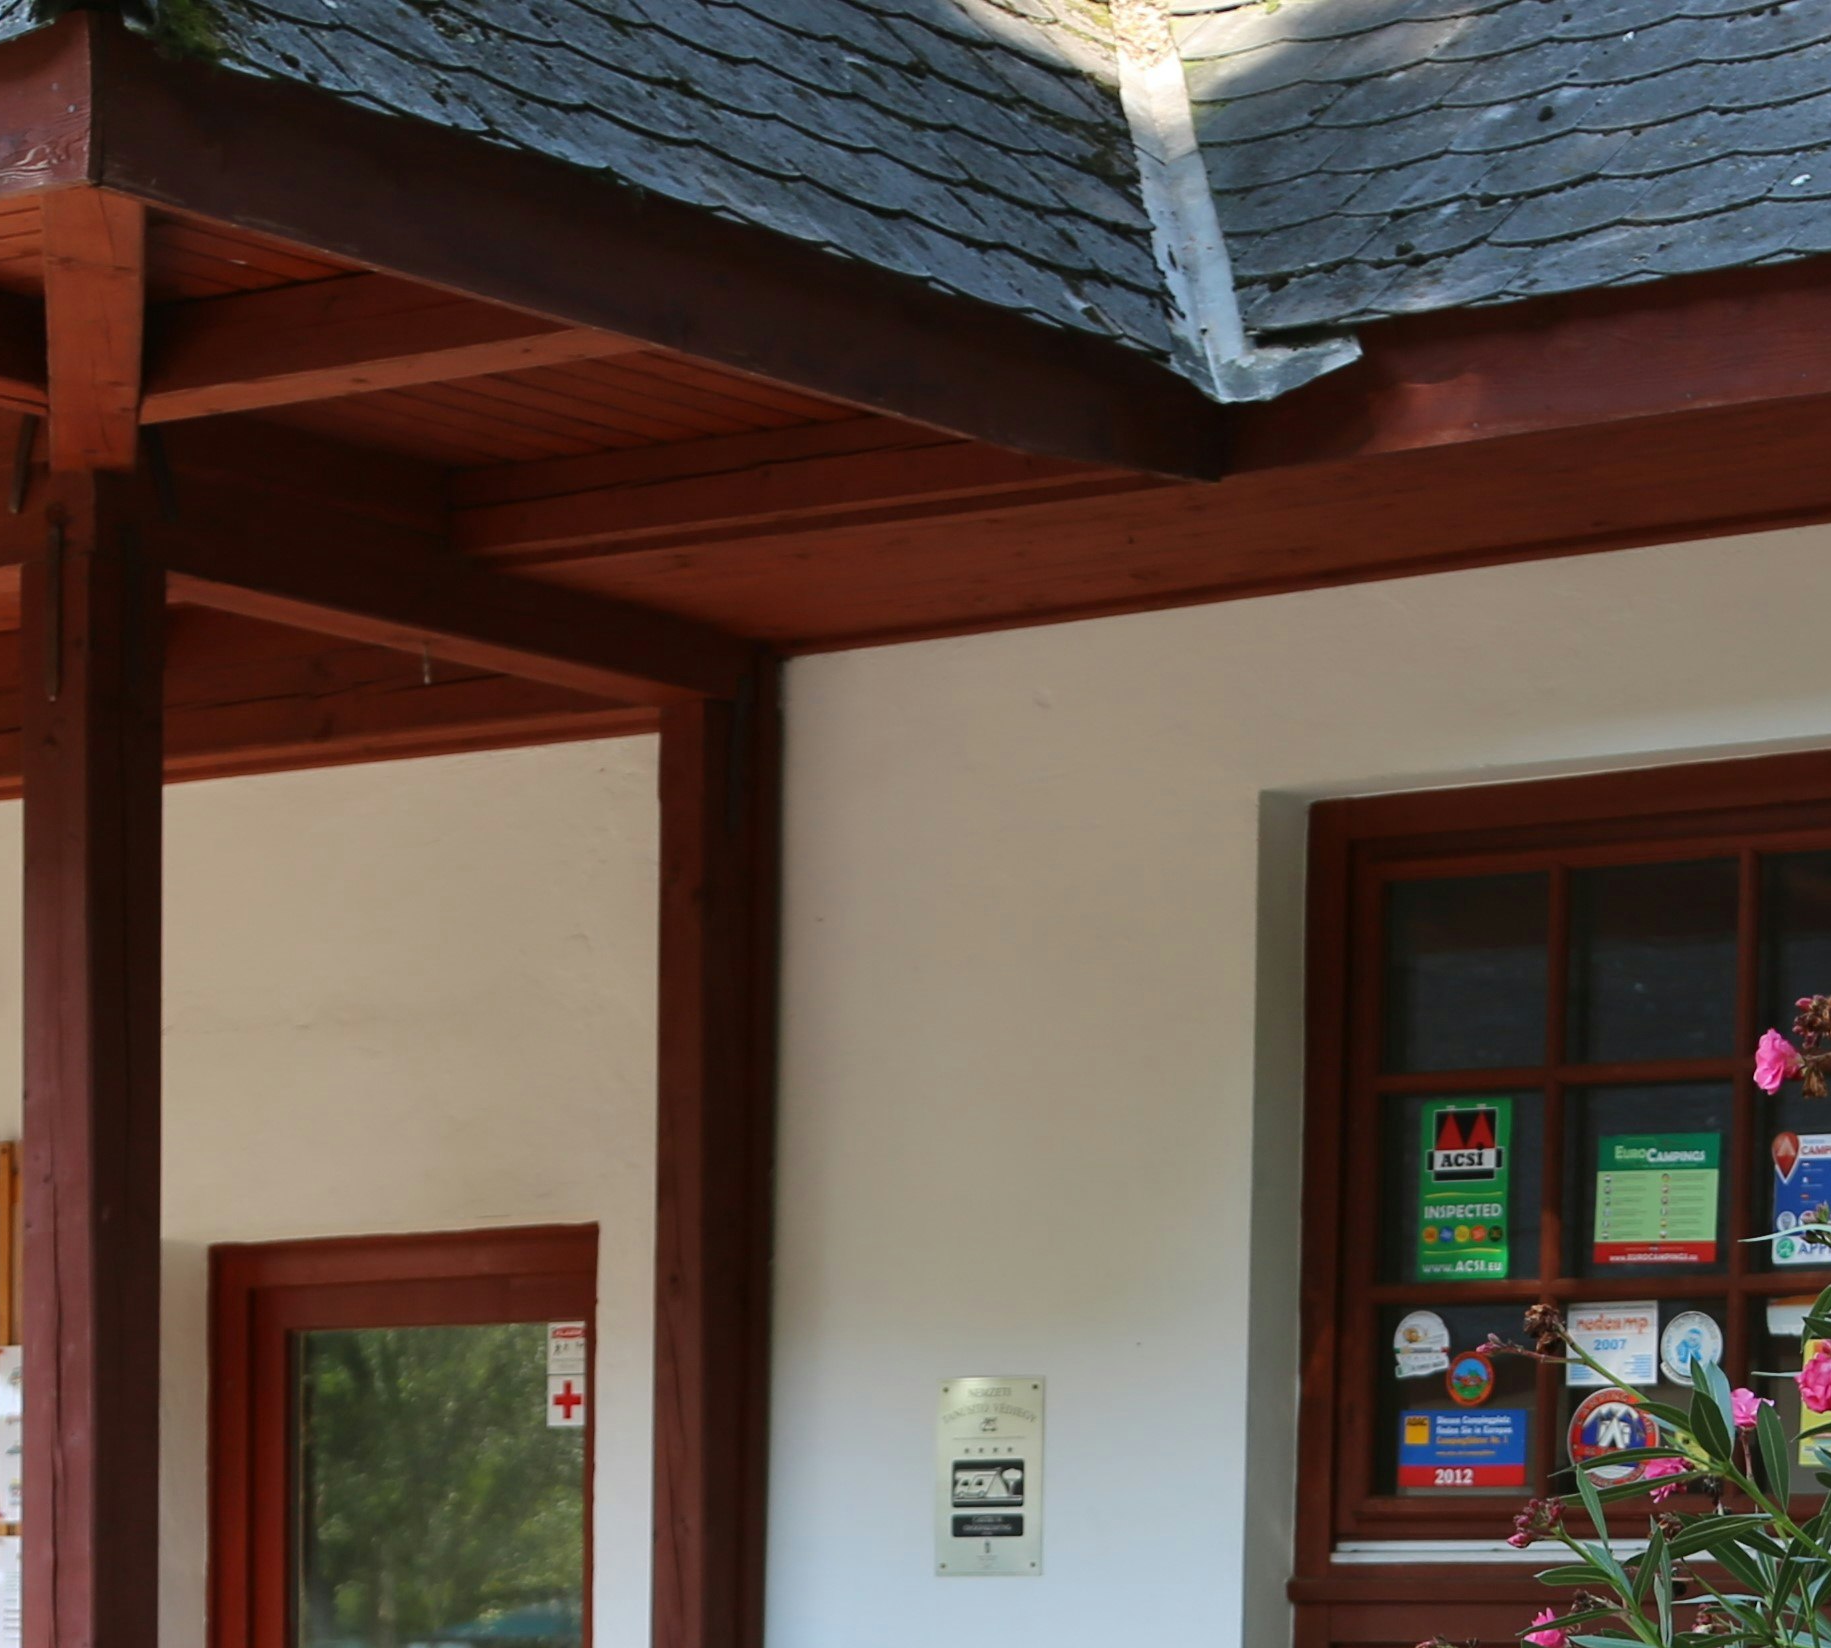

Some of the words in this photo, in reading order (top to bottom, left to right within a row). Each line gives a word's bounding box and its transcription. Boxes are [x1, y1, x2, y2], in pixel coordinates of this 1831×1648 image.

[1424, 1203, 1503, 1219] INSPECTED
[1593, 1338, 1628, 1351] 2007
[1434, 1468, 1474, 1485] 2012
